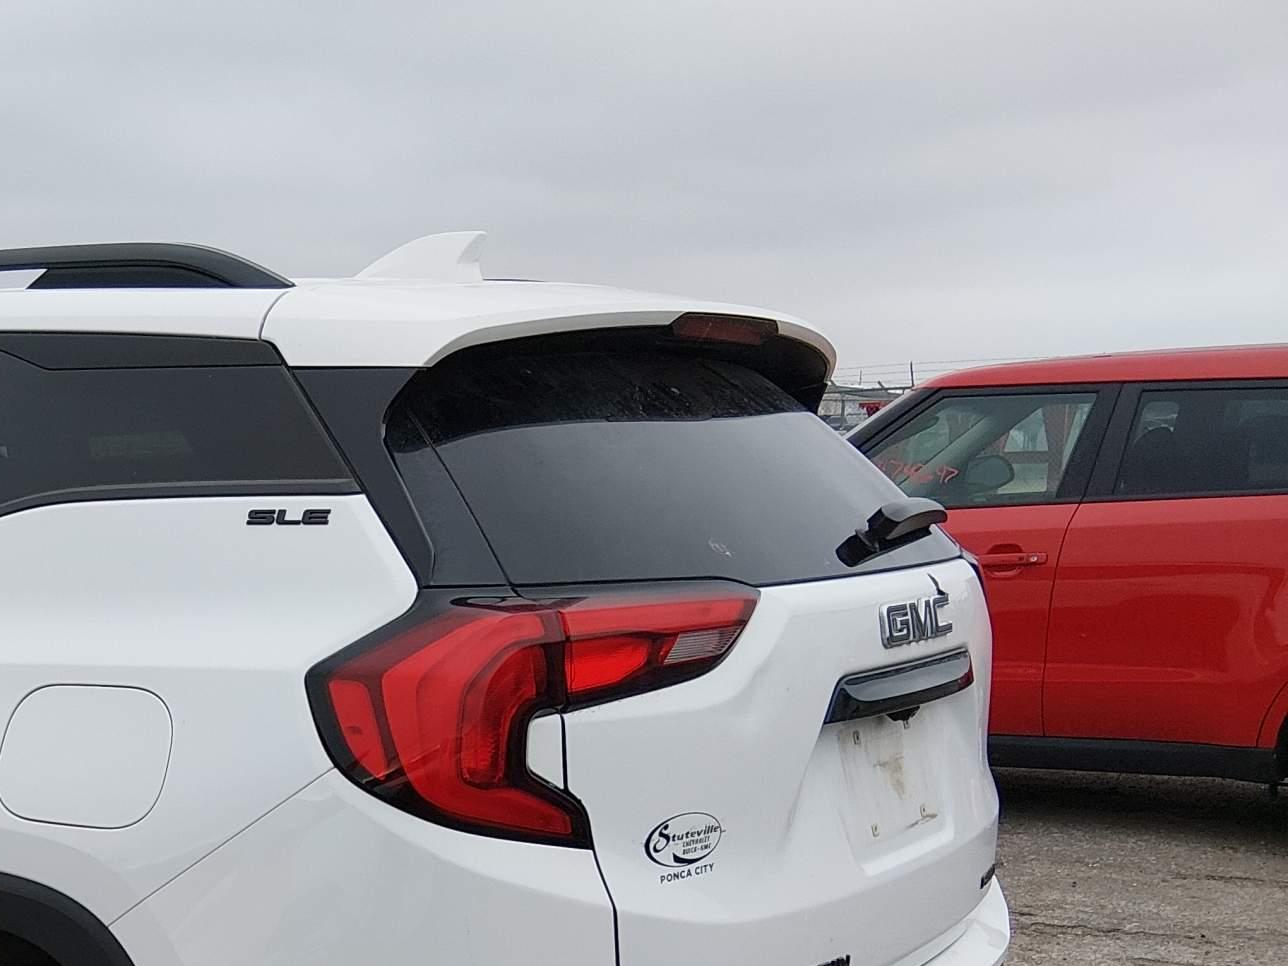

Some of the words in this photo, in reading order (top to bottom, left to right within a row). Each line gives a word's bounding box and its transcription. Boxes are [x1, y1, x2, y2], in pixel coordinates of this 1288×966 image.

[245, 508, 332, 526] SLE
[879, 593, 953, 649] GMC
[653, 823, 722, 854] Stuteville
[660, 868, 693, 884] PONCA
[694, 863, 716, 876] CITY
